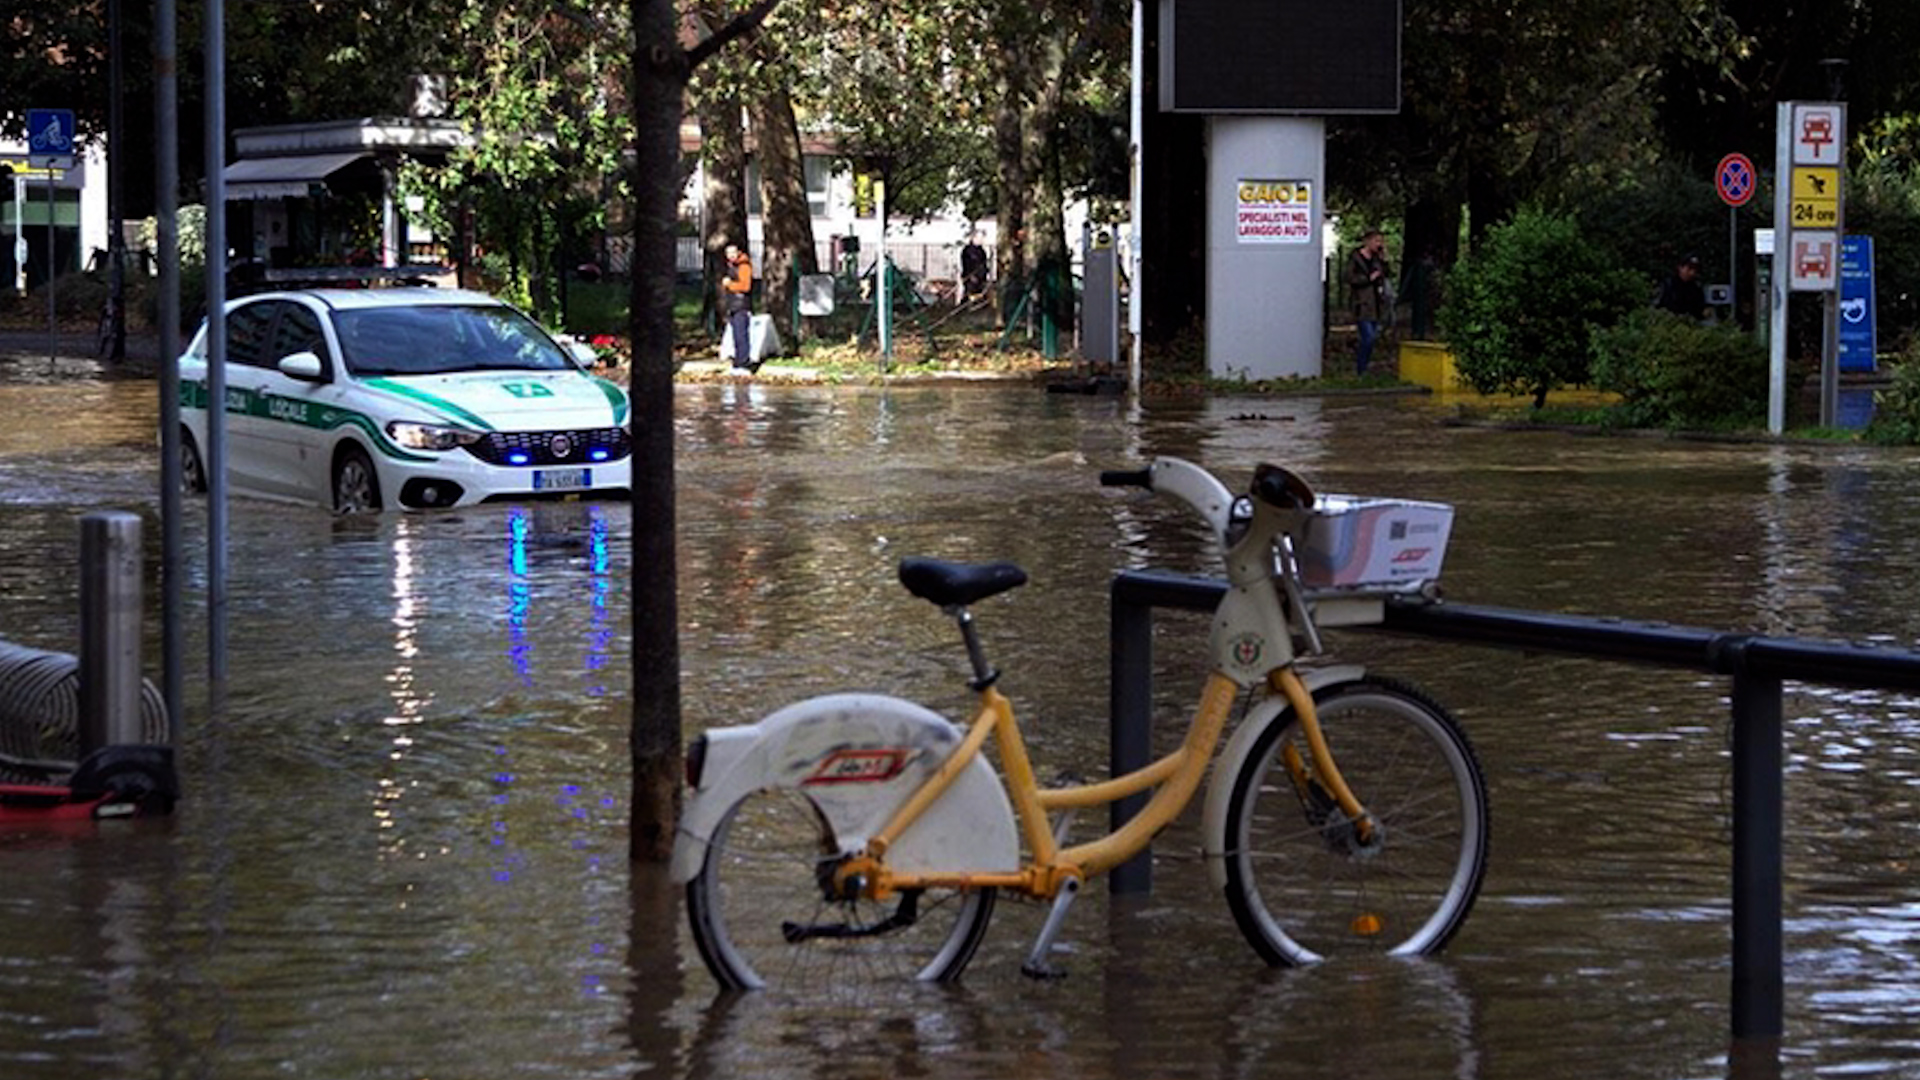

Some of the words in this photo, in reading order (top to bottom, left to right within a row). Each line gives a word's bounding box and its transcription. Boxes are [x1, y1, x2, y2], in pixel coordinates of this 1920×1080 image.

[1239, 185, 1291, 203] GAIO
[1239, 212, 1290, 222] SPECIALISTI
[1292, 212, 1308, 222] NEL
[1795, 204, 1813, 220] 24
[1817, 210, 1835, 221] ore
[1239, 225, 1282, 236] LAVAGGIO
[1284, 225, 1308, 236] AUTO
